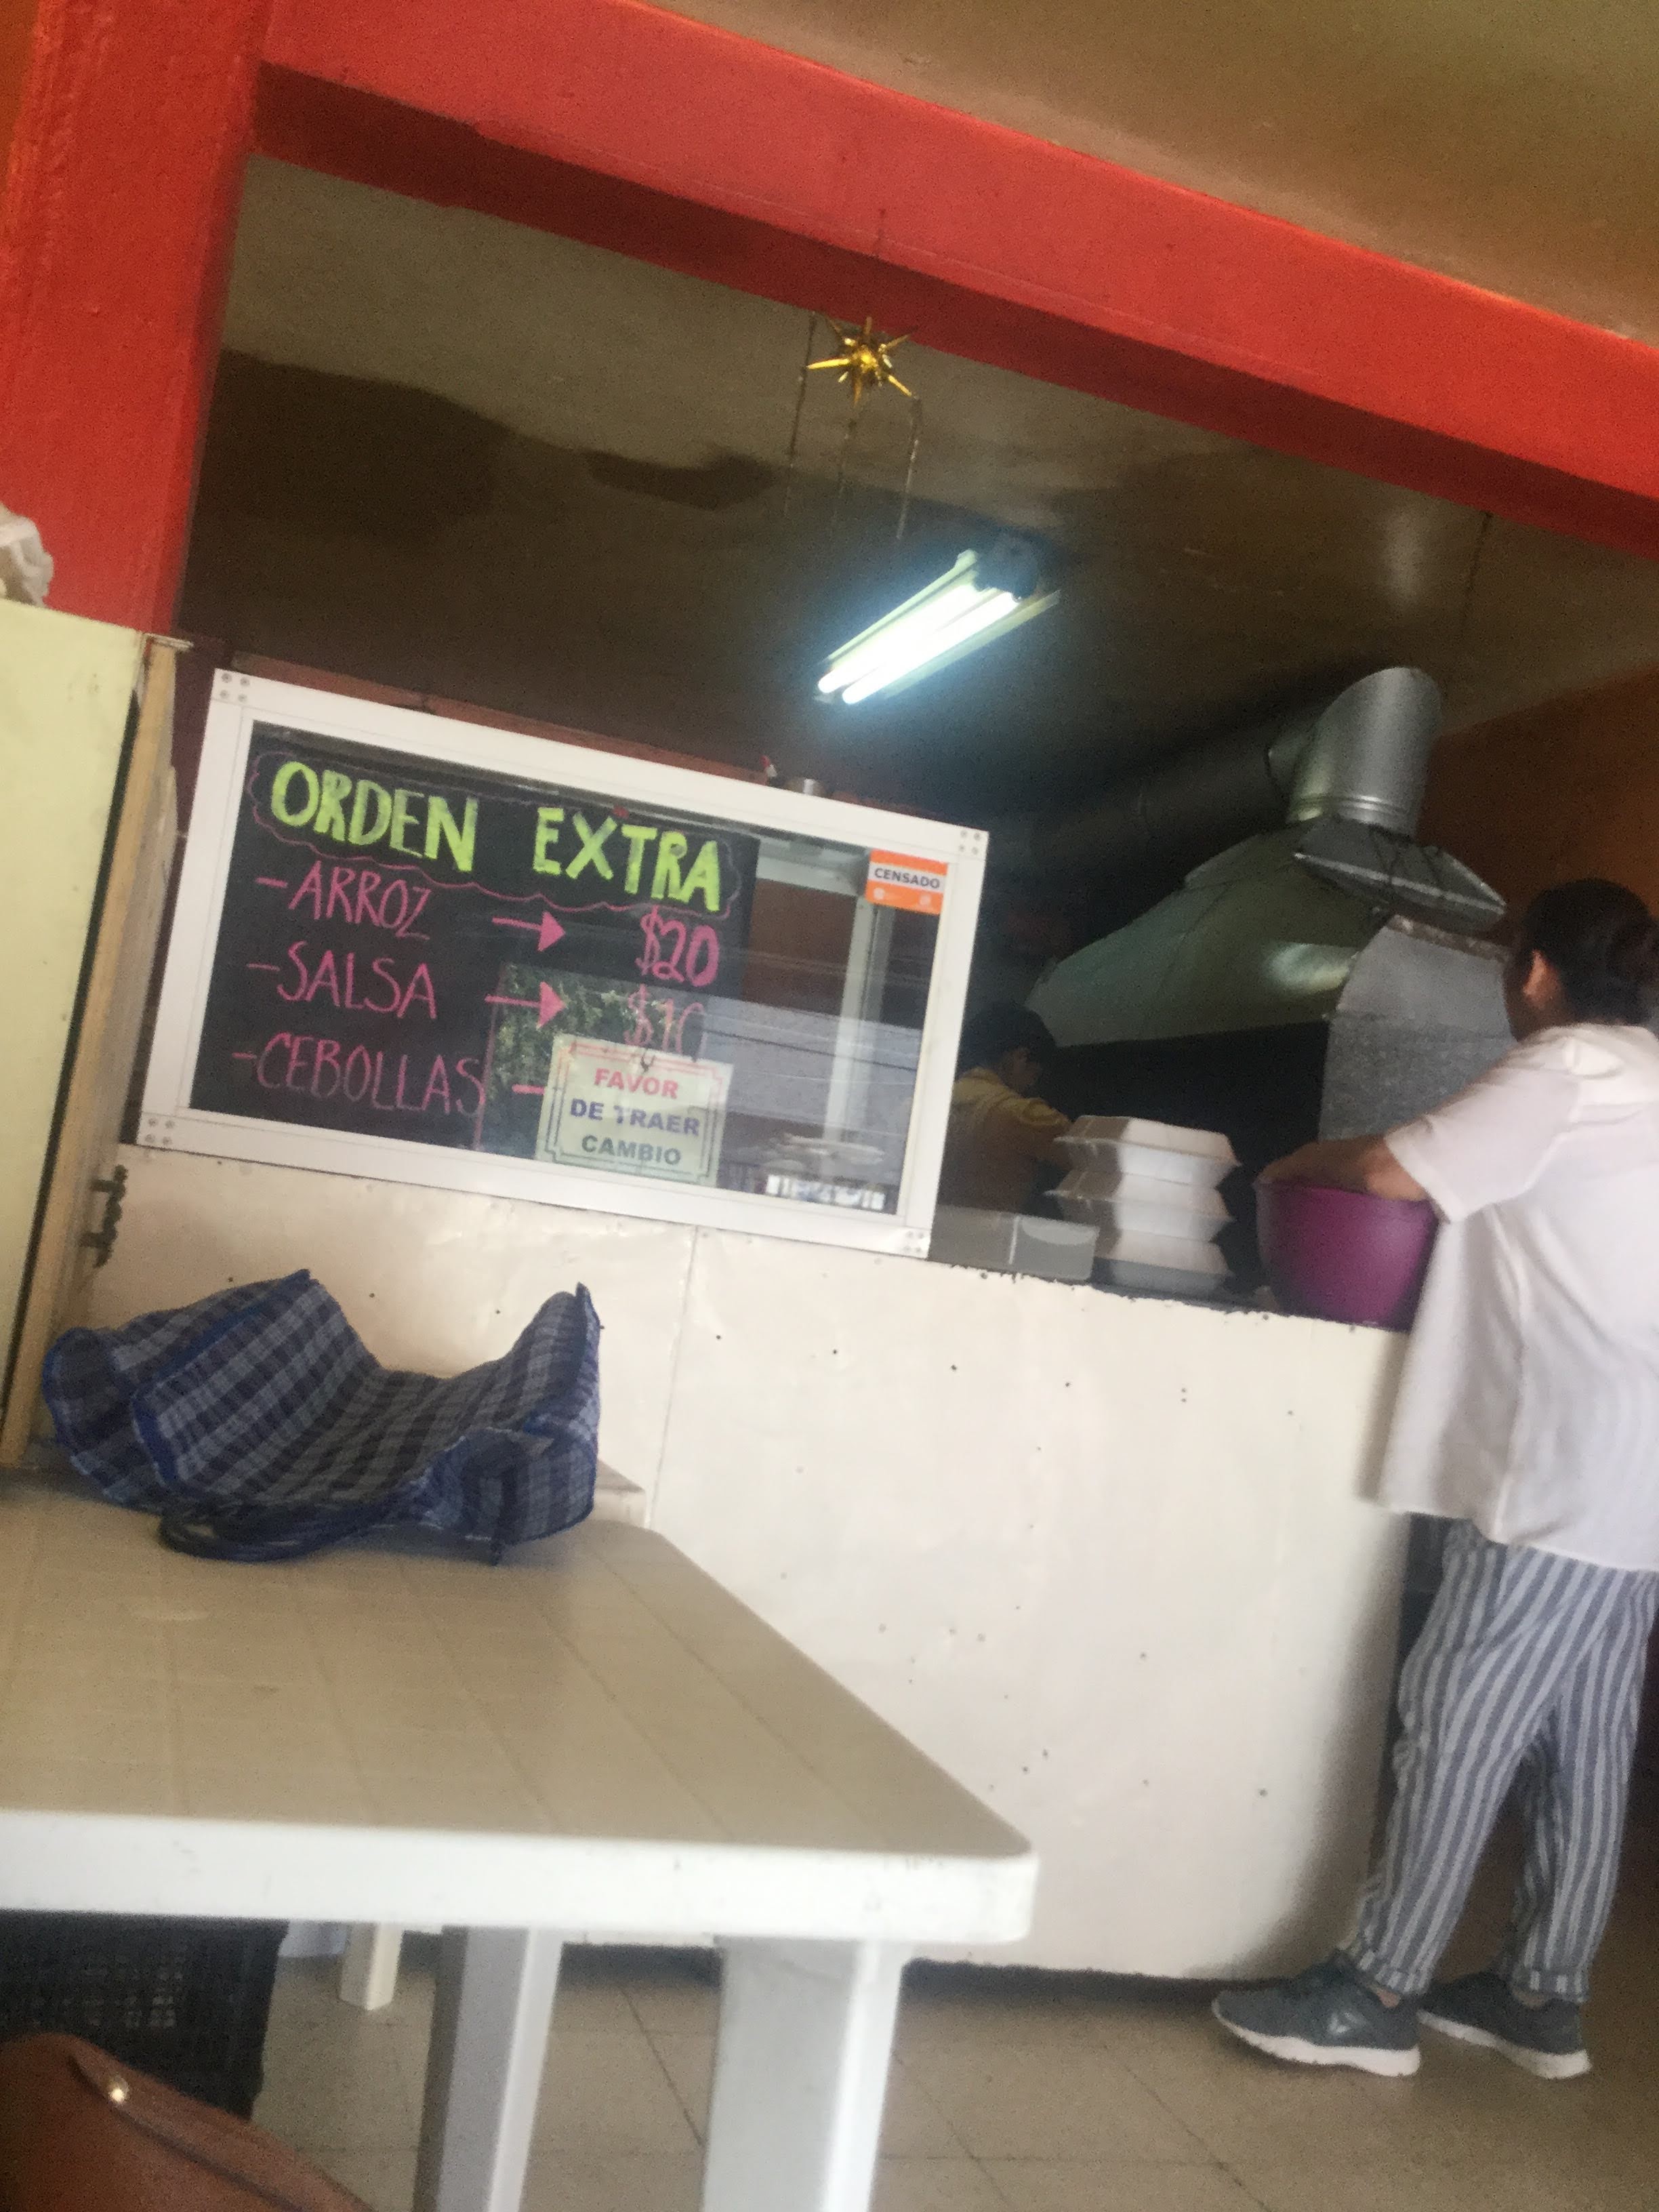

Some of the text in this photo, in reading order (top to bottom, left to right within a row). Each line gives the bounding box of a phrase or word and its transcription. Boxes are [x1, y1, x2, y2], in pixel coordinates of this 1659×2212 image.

[271, 760, 720, 912] ORDEN EXTRA
[874, 867, 940, 889] CENSADO
[635, 905, 720, 987] $20
[594, 1067, 679, 1099] FAVOR
[570, 1098, 700, 1136] DE TRAER
[581, 1134, 682, 1165] CAMBIO
